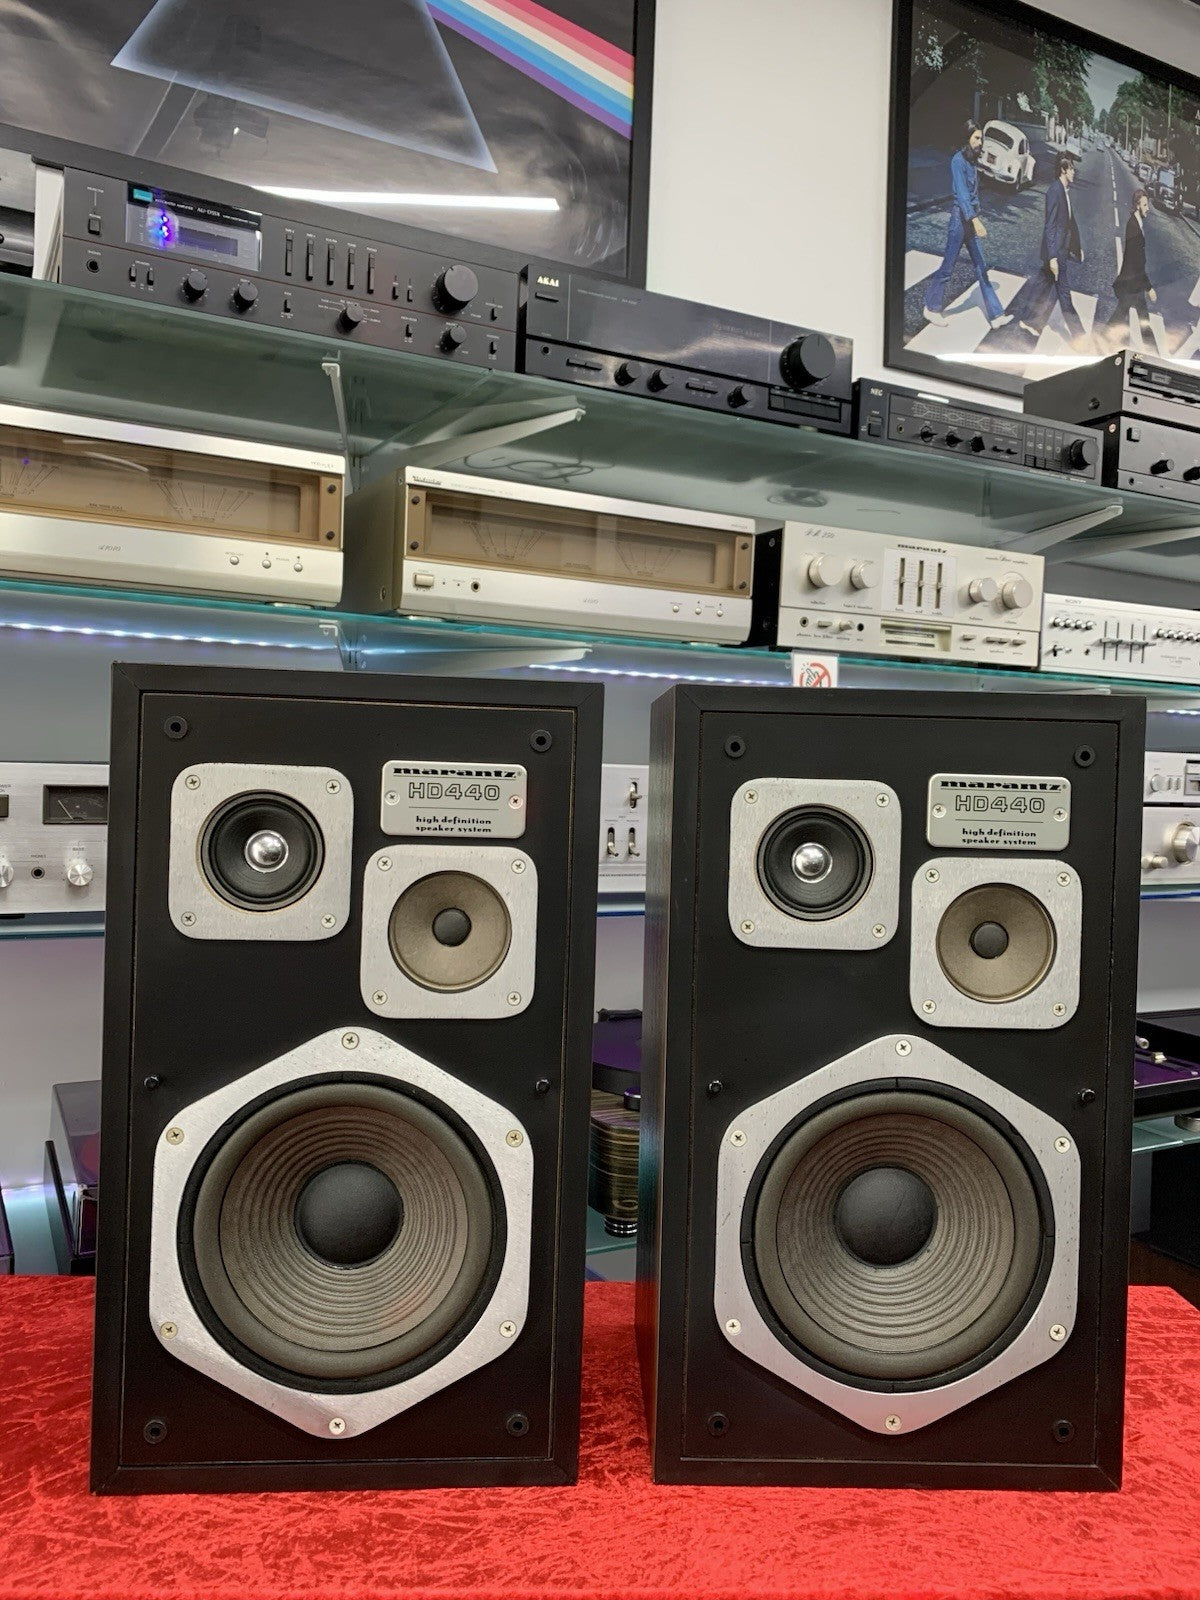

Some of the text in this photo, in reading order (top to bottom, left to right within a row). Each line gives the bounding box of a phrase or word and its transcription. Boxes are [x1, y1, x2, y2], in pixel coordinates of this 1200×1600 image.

[537, 275, 559, 287] AKAI
[870, 387, 883, 397] NEC
[393, 767, 517, 778] marantz
[940, 780, 1061, 791] marantz
[408, 782, 500, 801] HD440
[955, 795, 1045, 813] HD440
[415, 815, 491, 826] high definition
[415, 824, 454, 832] speaker
[962, 828, 1036, 837] high definition
[962, 837, 1036, 846] speaker system
